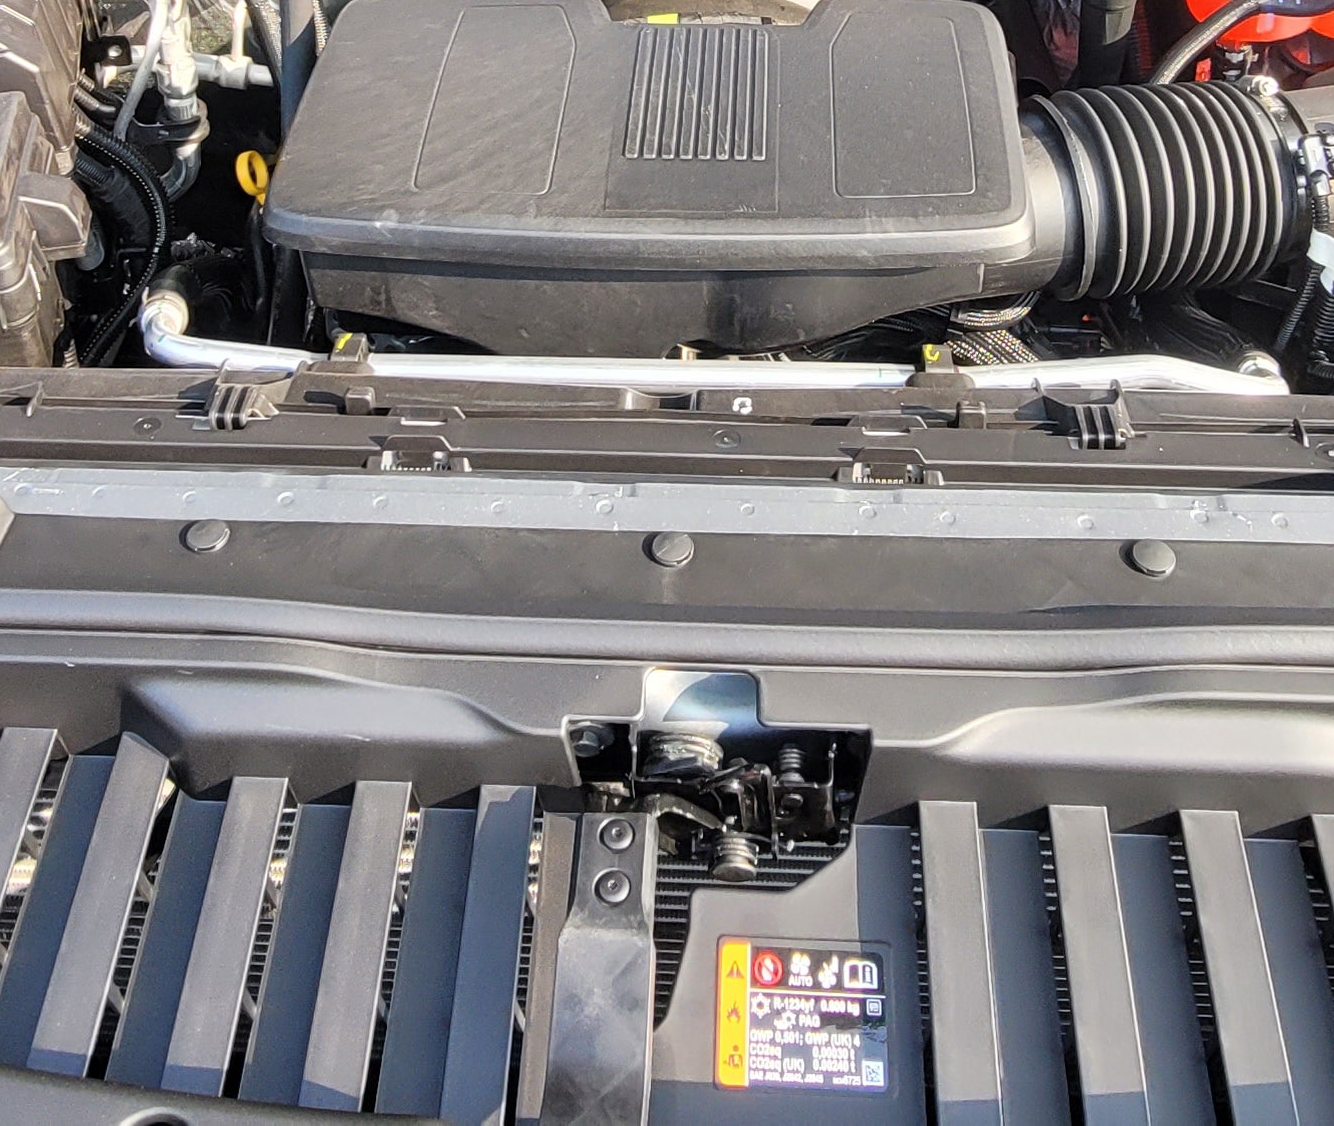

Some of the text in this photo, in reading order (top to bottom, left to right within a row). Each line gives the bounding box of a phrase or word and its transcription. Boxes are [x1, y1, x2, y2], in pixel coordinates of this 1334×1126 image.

[789, 975, 813, 986] AUTO
[774, 996, 815, 1013] R-1234yf
[847, 1001, 860, 1016] kg
[799, 1015, 820, 1027] PAG
[750, 1029, 773, 1042] GWP
[805, 1032, 829, 1045] GWP
[831, 1034, 851, 1049] (UK)
[853, 1034, 860, 1047] 4
[783, 1058, 804, 1073] (UK)
